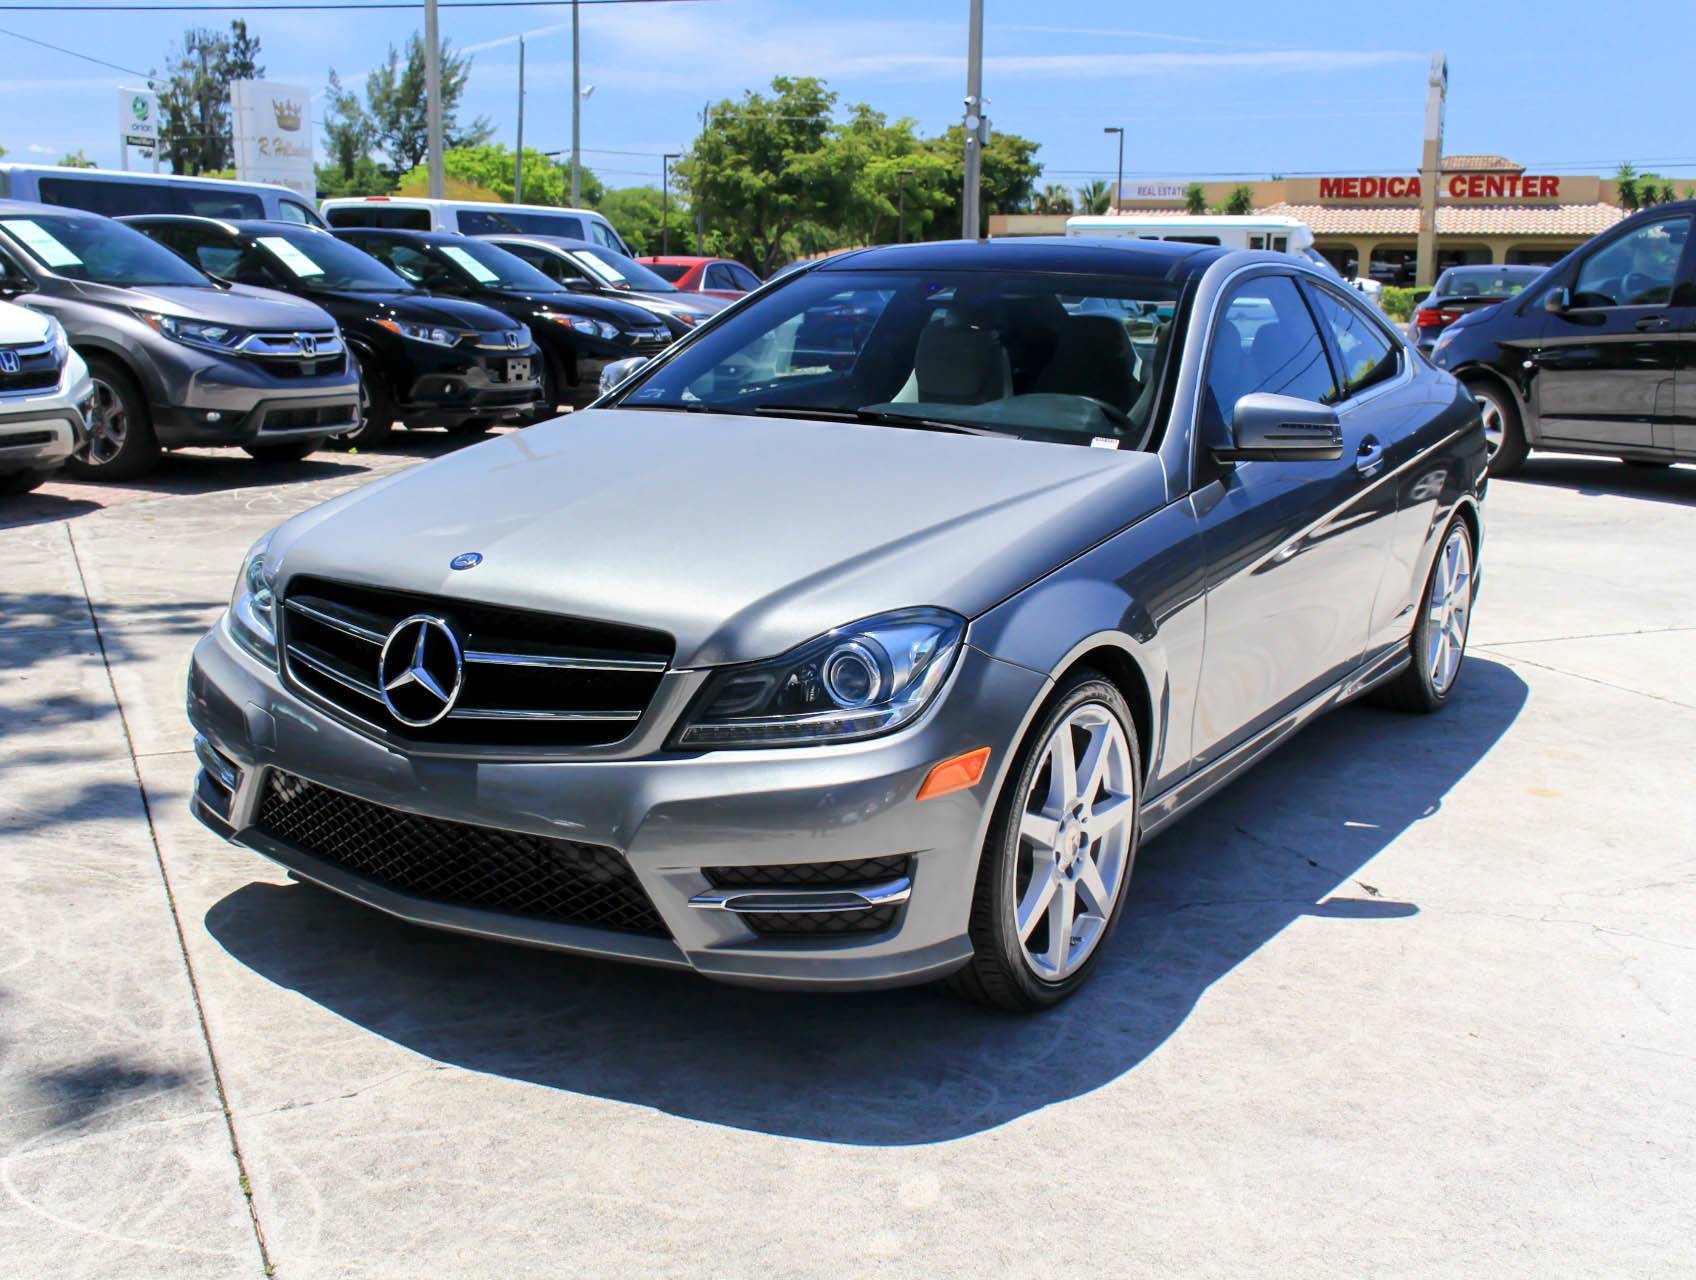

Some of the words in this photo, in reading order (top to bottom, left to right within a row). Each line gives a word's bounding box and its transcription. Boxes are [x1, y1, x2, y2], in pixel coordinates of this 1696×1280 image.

[1137, 186, 1157, 196] REAL
[1320, 177, 1421, 198] MEDICA
[1449, 175, 1560, 197] CENTER
